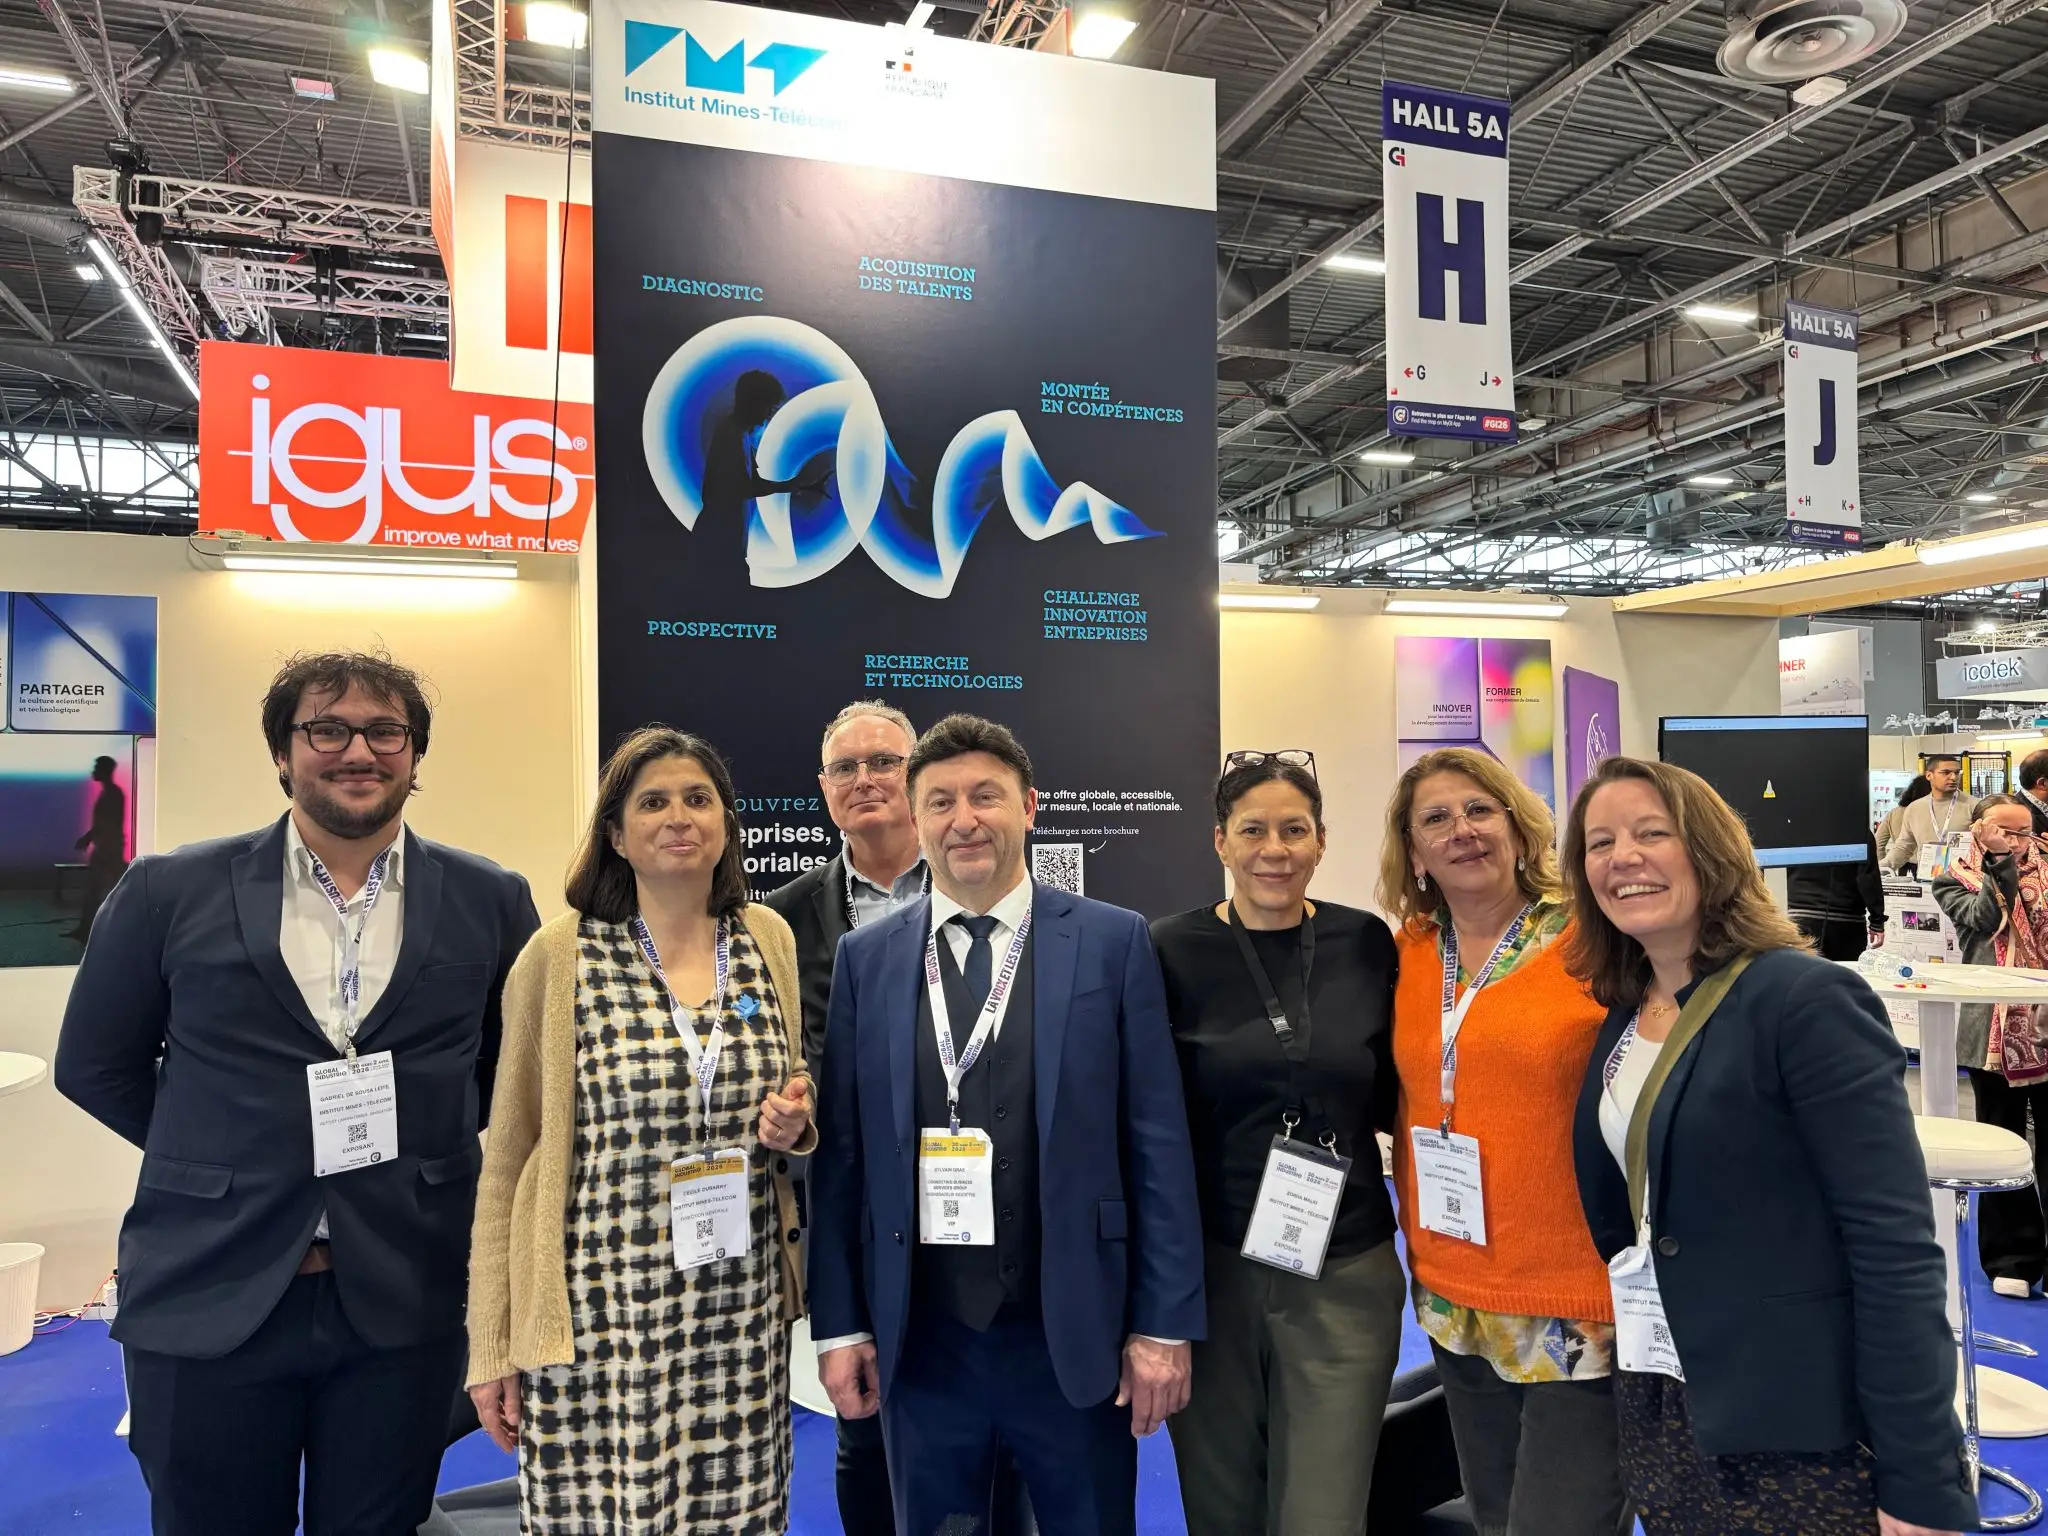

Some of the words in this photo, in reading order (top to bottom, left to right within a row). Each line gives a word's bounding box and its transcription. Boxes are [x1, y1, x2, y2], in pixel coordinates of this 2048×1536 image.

[624, 86, 696, 111] Institut
[1392, 98, 1460, 134] HALL
[1467, 111, 1504, 141] 5A
[1416, 191, 1487, 326] H
[859, 256, 976, 282] ACQUISITION
[642, 275, 763, 302] DIAGNOSTIC
[859, 275, 892, 292] DES
[896, 280, 973, 301] TALENTS
[1790, 312, 1830, 336] HALL
[1833, 320, 1855, 341] 5A
[1417, 365, 1426, 380] G
[1480, 372, 1488, 386] J
[1041, 382, 1110, 400] MONTÉE
[1041, 399, 1063, 413] EN
[1067, 401, 1184, 422] COMPÉTENCES
[1484, 419, 1508, 429] #GI26
[1813, 378, 1836, 466] J
[1805, 495, 1811, 506] H
[1841, 499, 1847, 511] K
[384, 525, 461, 545] improve
[466, 531, 513, 548] what
[518, 537, 579, 551] moves
[1044, 590, 1140, 607] CHALLENGE
[1044, 608, 1148, 624] INNOVATION
[647, 620, 777, 639] PROSPECTIVE
[1044, 625, 1148, 642] ENTREPRISES
[865, 654, 969, 671] RECHERCHE
[1964, 657, 2020, 681] icotek
[20, 683, 105, 696] PARTAGER
[865, 672, 887, 688] ET
[891, 673, 1023, 690] TECHNOLOGIES
[1486, 687, 1522, 696] FORMER
[28, 706, 81, 714] technologique
[1432, 704, 1472, 713] INNOVER
[1053, 790, 1077, 799] offre
[1079, 790, 1118, 801] globale,
[1120, 790, 1174, 801] accessible,
[735, 798, 820, 811] ouvrez
[1036, 803, 1047, 811] ur
[1050, 803, 1090, 812] mesure,
[1092, 802, 1122, 811] locale
[1123, 803, 1134, 811] et
[1136, 802, 1183, 811] nationale.
[1032, 827, 1080, 837] Téléchargez
[1104, 826, 1140, 835] brochure
[743, 852, 828, 873] oriales
[1505, 920, 1526, 944] VOICE
[991, 981, 1008, 1003] VOIX
[1000, 967, 1011, 983] ET
[1006, 954, 1018, 973] LES
[352, 1067, 370, 1075] 2026
[319, 1106, 344, 1116] INSTITUT
[345, 1103, 363, 1111] MINES
[342, 1142, 375, 1154] EXPOSANT
